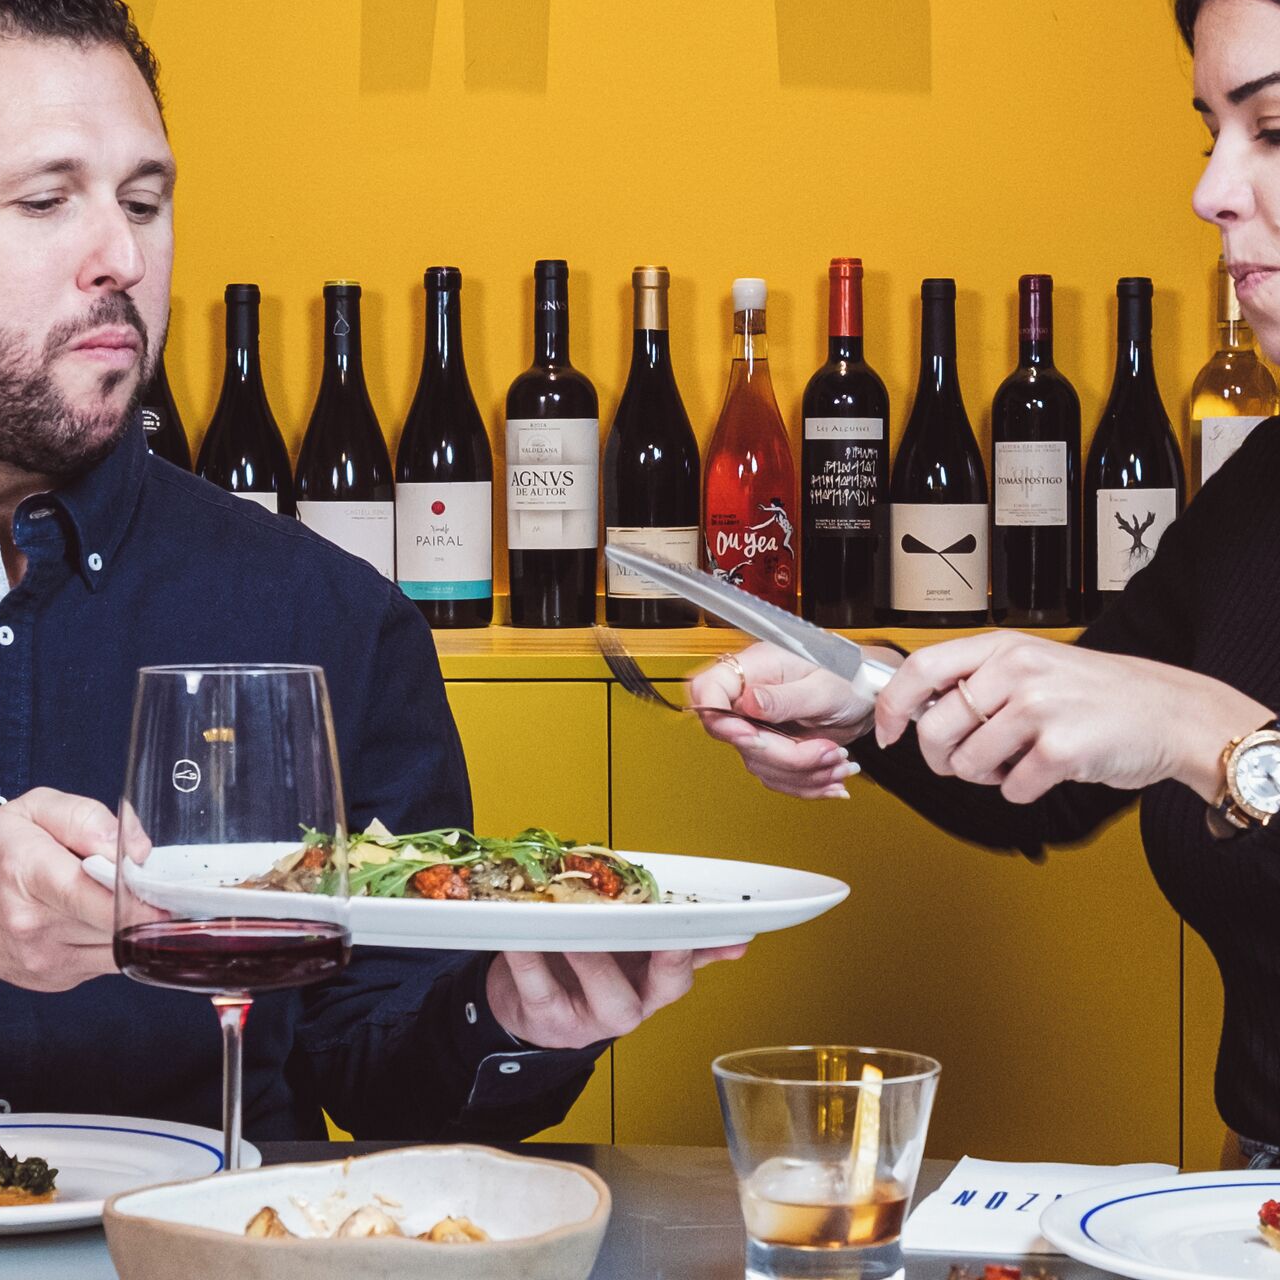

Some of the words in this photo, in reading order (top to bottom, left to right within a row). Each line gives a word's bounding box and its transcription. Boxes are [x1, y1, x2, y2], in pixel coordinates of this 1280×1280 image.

[511, 471, 574, 487] AGNVS
[1024, 476, 1063, 485] POSTIGO
[516, 487, 529, 496] DE
[530, 487, 567, 496] AUTOR
[416, 535, 464, 547] PAIRAL
